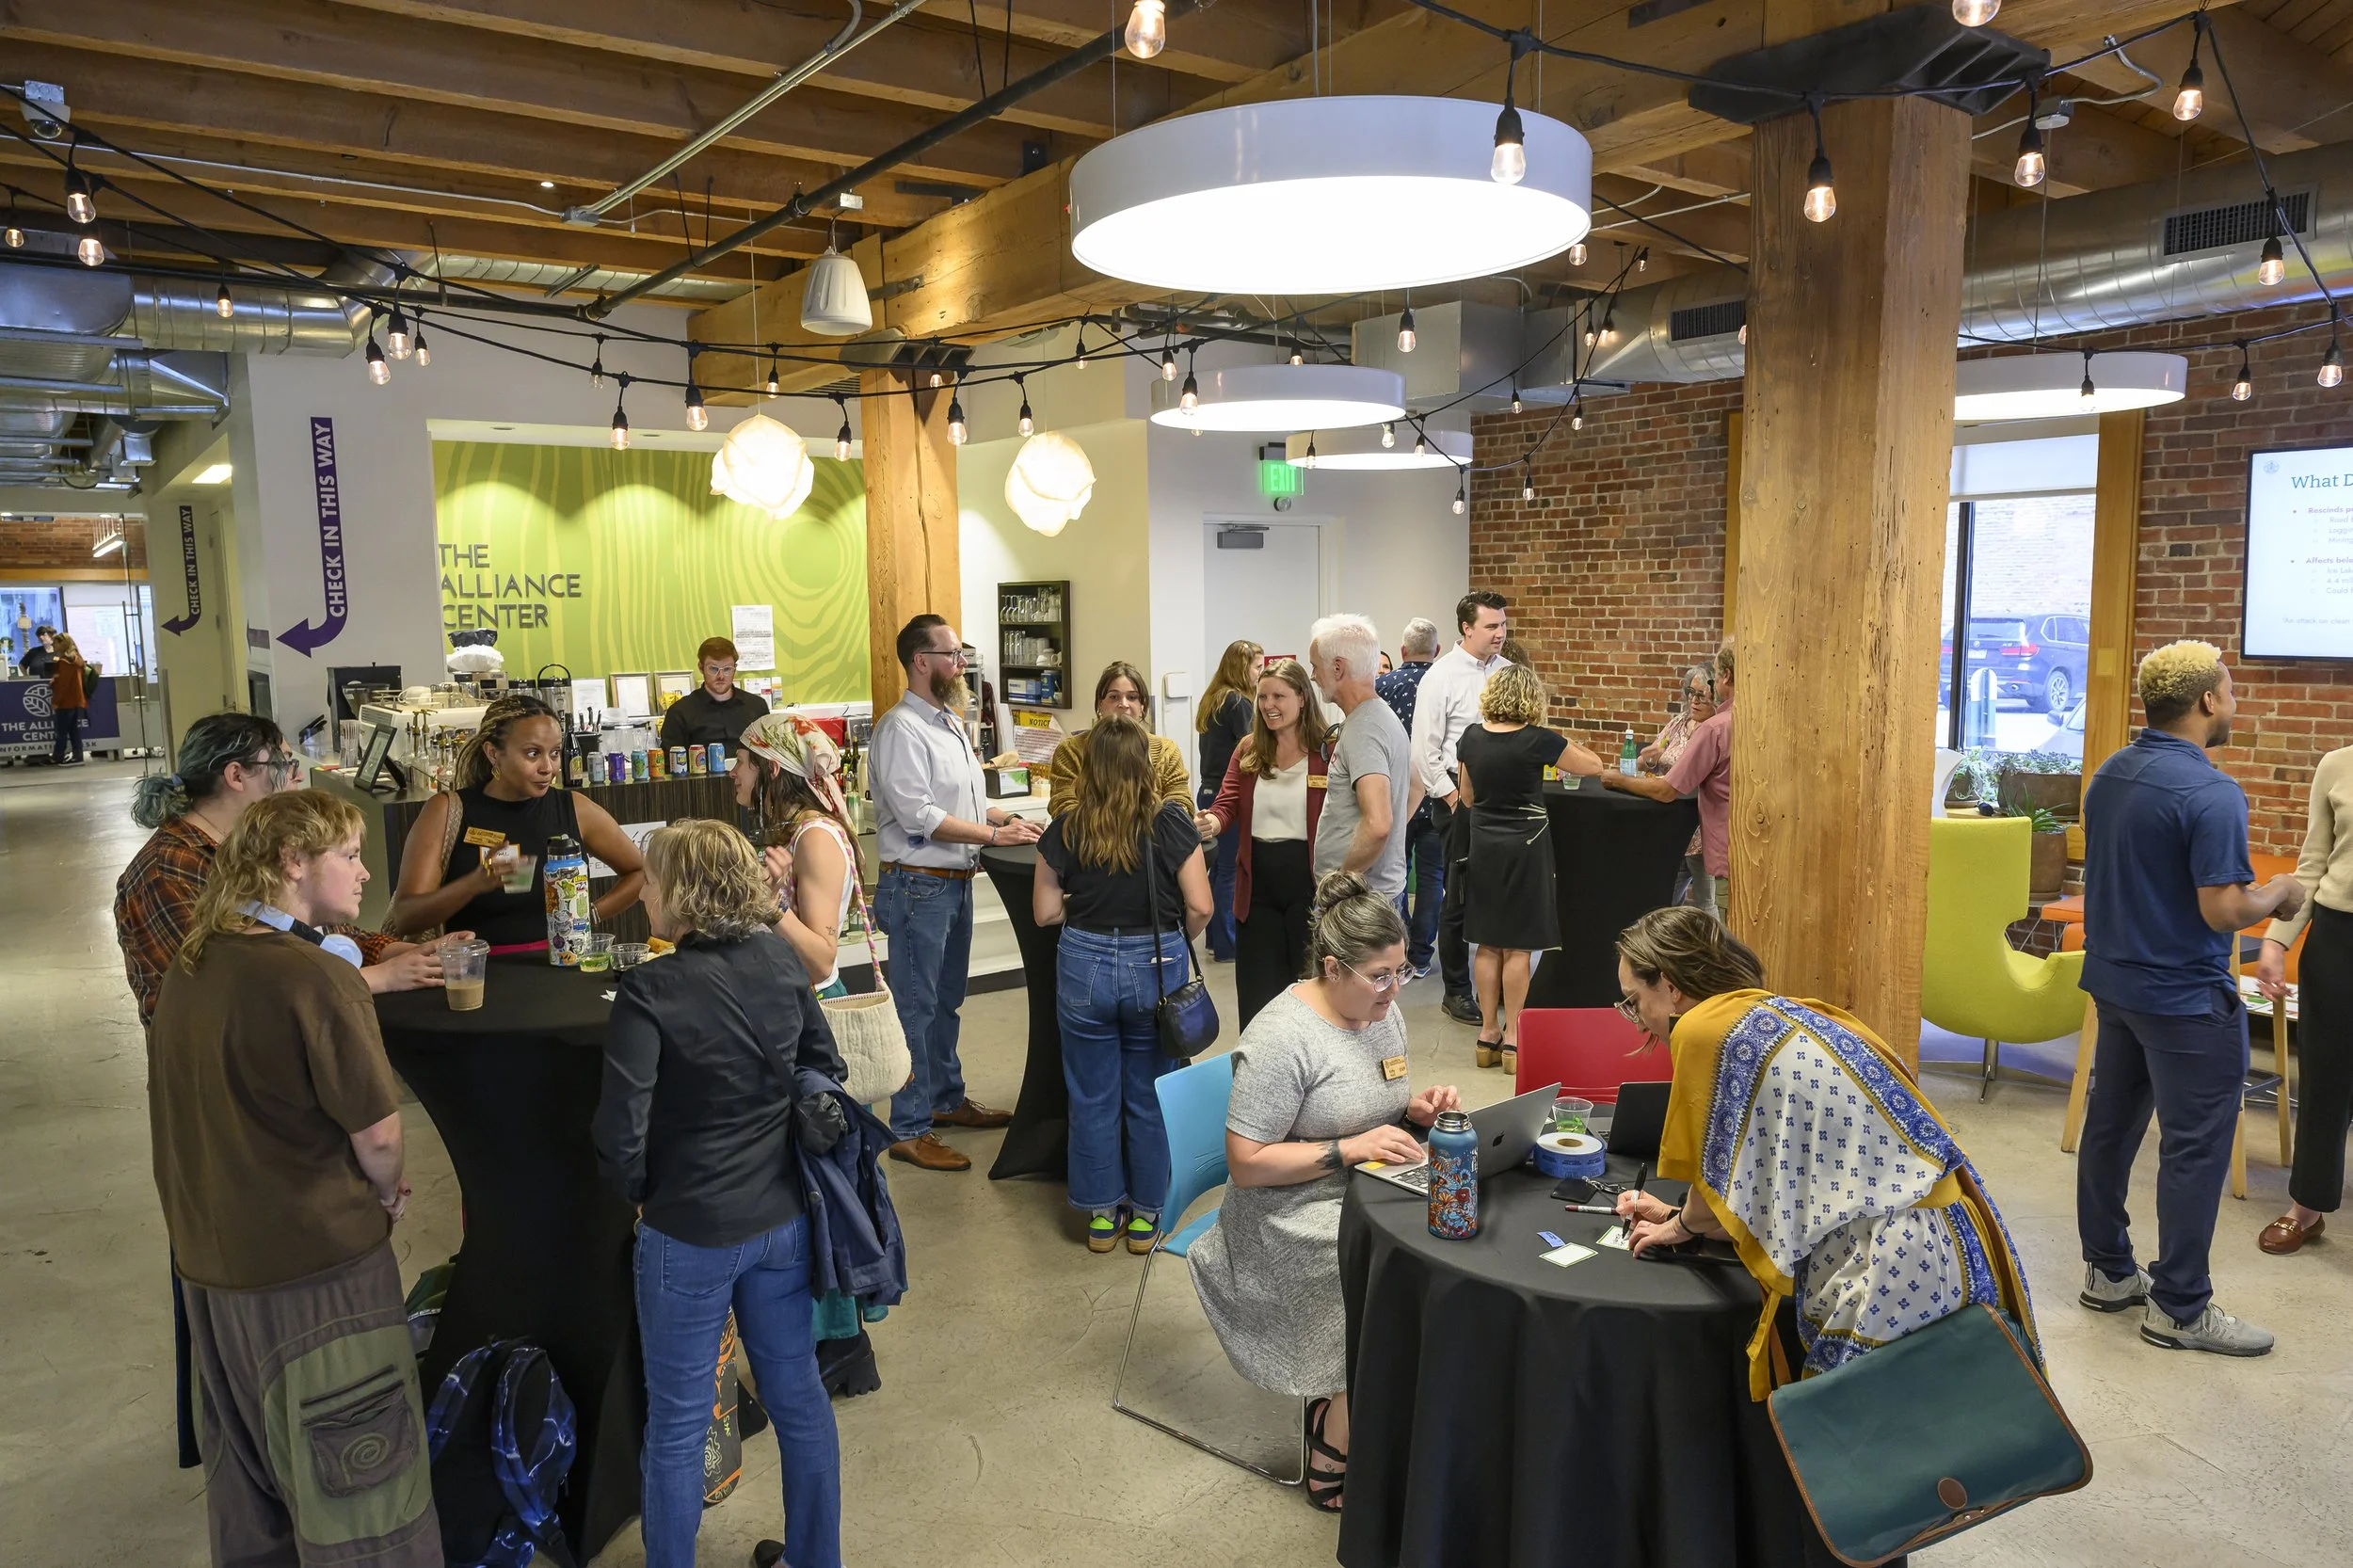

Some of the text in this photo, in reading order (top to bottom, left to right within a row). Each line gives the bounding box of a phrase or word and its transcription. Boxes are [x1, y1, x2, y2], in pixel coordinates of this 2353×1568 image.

[1271, 464, 1296, 491] EXIT
[2291, 474, 2339, 488] What
[314, 423, 345, 617] CHECK IN THIS WAY
[181, 509, 200, 615] CHECK IN THIS WAY
[439, 543, 490, 568] THE
[441, 573, 582, 599] ALLIANCE
[442, 603, 549, 629] CENTER
[1, 722, 26, 731] THE
